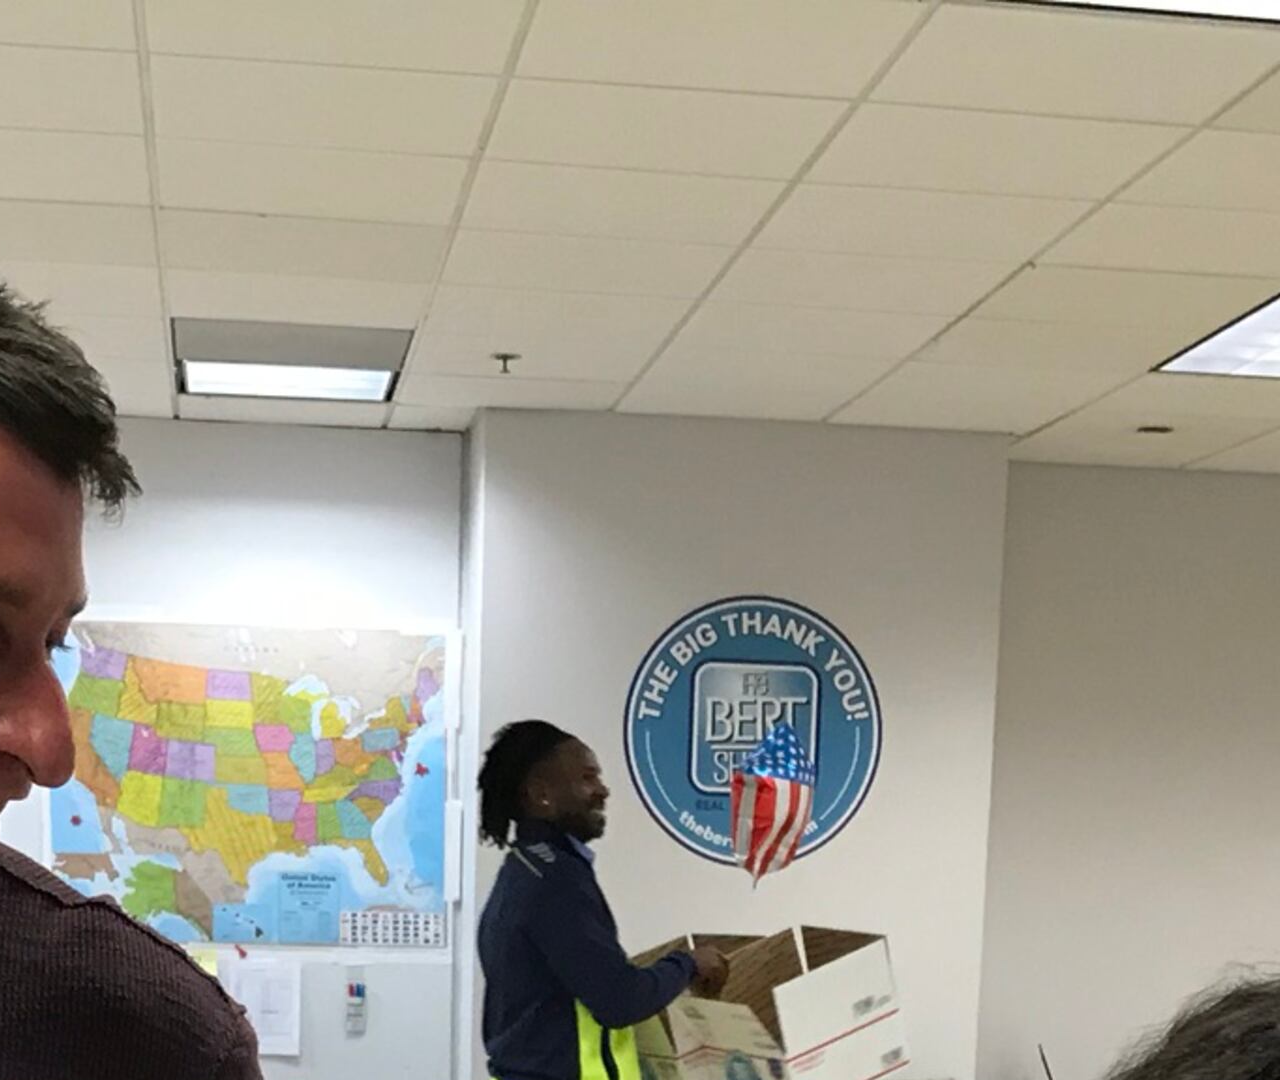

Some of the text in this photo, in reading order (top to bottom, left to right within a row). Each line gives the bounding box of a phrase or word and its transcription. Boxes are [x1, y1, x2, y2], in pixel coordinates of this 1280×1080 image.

[638, 611, 869, 721] THE BIG THANK YOU!
[705, 696, 808, 742] BERT
